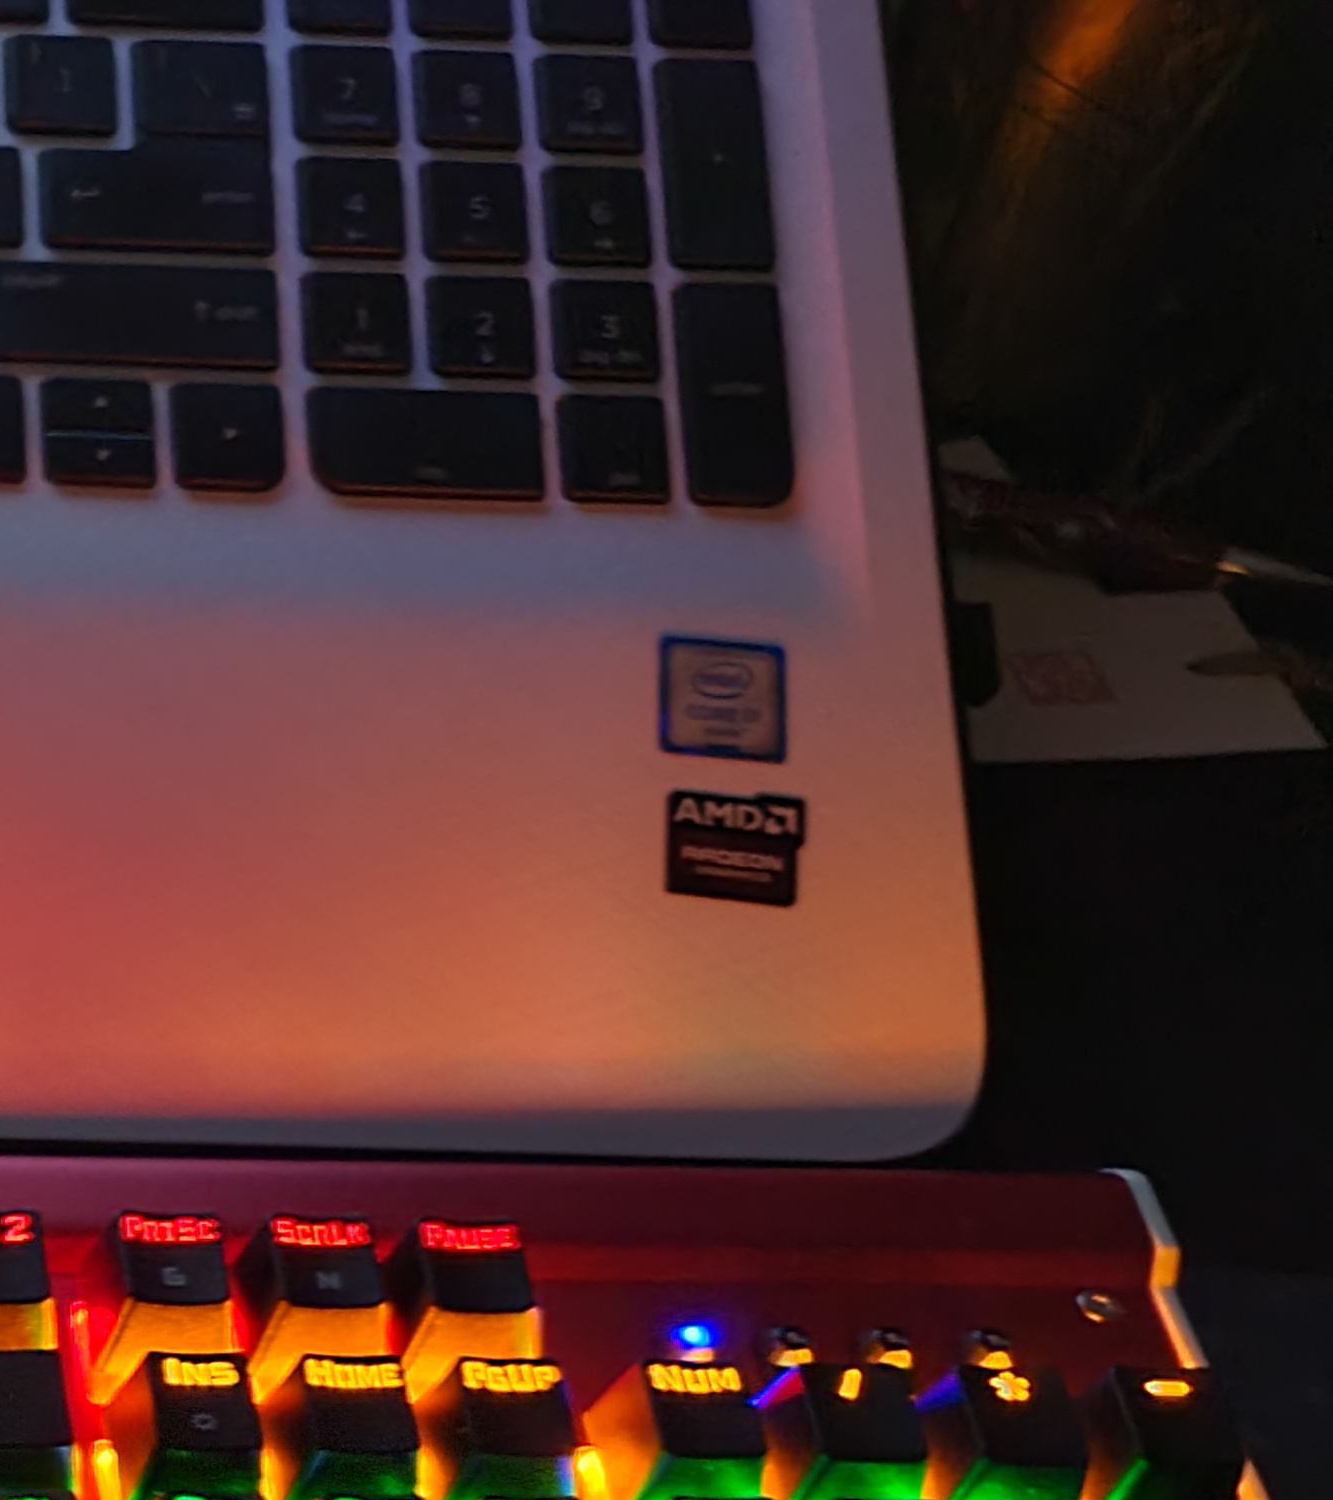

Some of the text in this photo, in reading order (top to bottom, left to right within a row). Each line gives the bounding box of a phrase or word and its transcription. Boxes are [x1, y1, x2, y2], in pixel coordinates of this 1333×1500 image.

[469, 196, 489, 220] 5
[475, 312, 495, 336] 2
[601, 315, 619, 338] 3
[673, 798, 763, 830] AMD
